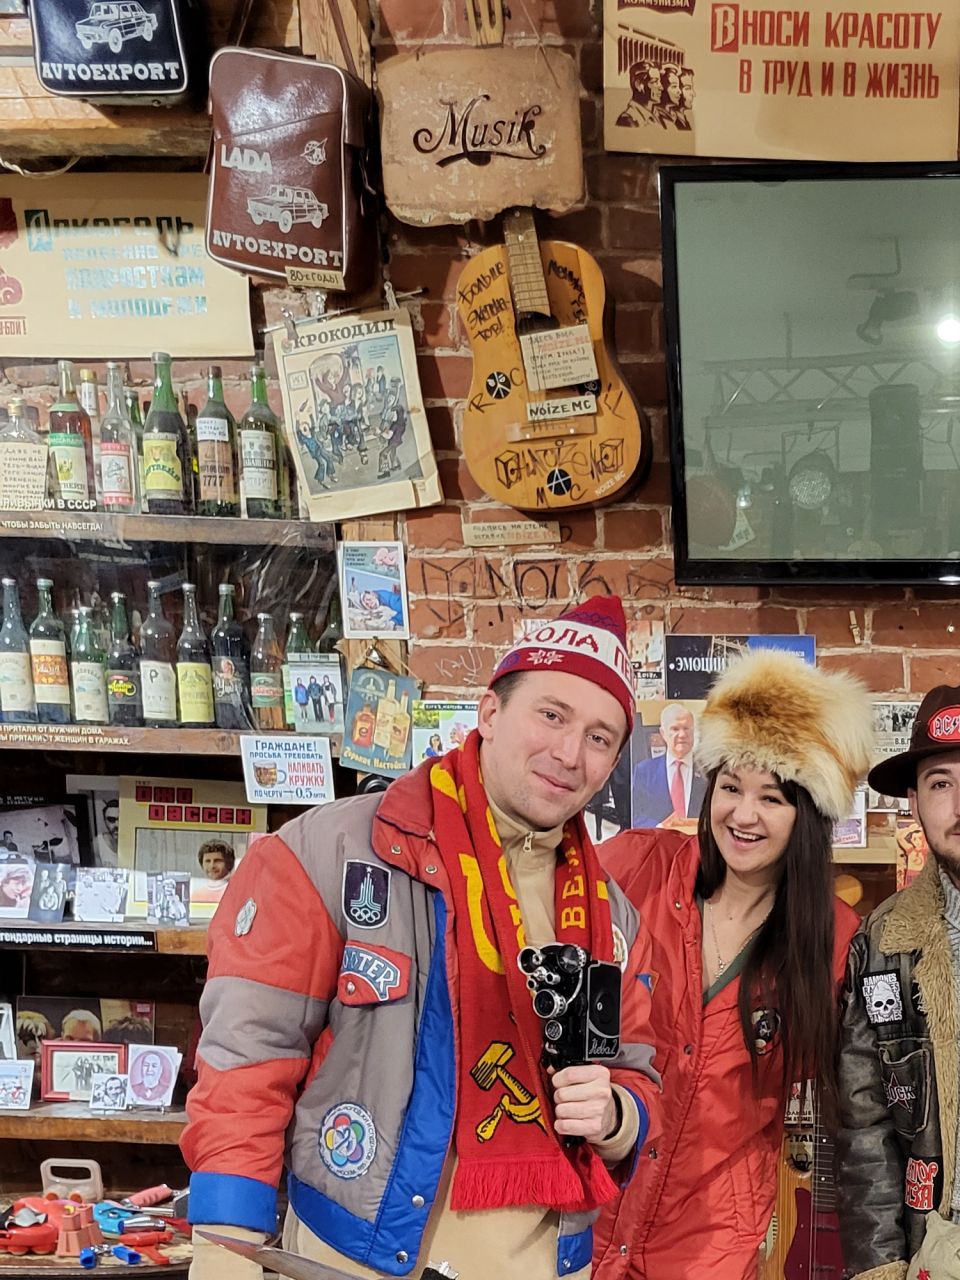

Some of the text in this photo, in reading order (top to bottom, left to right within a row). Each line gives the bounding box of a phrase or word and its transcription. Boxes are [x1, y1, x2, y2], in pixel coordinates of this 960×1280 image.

[711, 3, 942, 52] ВНОСИ КРАСОТУ
[42, 62, 180, 81] AVTOEXPORT
[739, 59, 940, 99] В ТРУД И В ЖИЗНЬ
[413, 94, 550, 167] Musik
[221, 144, 273, 174] LADA
[213, 230, 343, 267] AVTOEXPORT
[293, 318, 396, 350] КРОКОДИЛ
[572, 400, 592, 411] MC
[255, 739, 317, 752] ГРАЖДАНЕ!
[250, 751, 323, 760] ПРОСЬБА ТРЕБОВАТЬ
[288, 761, 324, 774] НАЛИВАТЬ
[288, 775, 325, 787] КРУЖКУ
[863, 972, 897, 986] RAMONES
